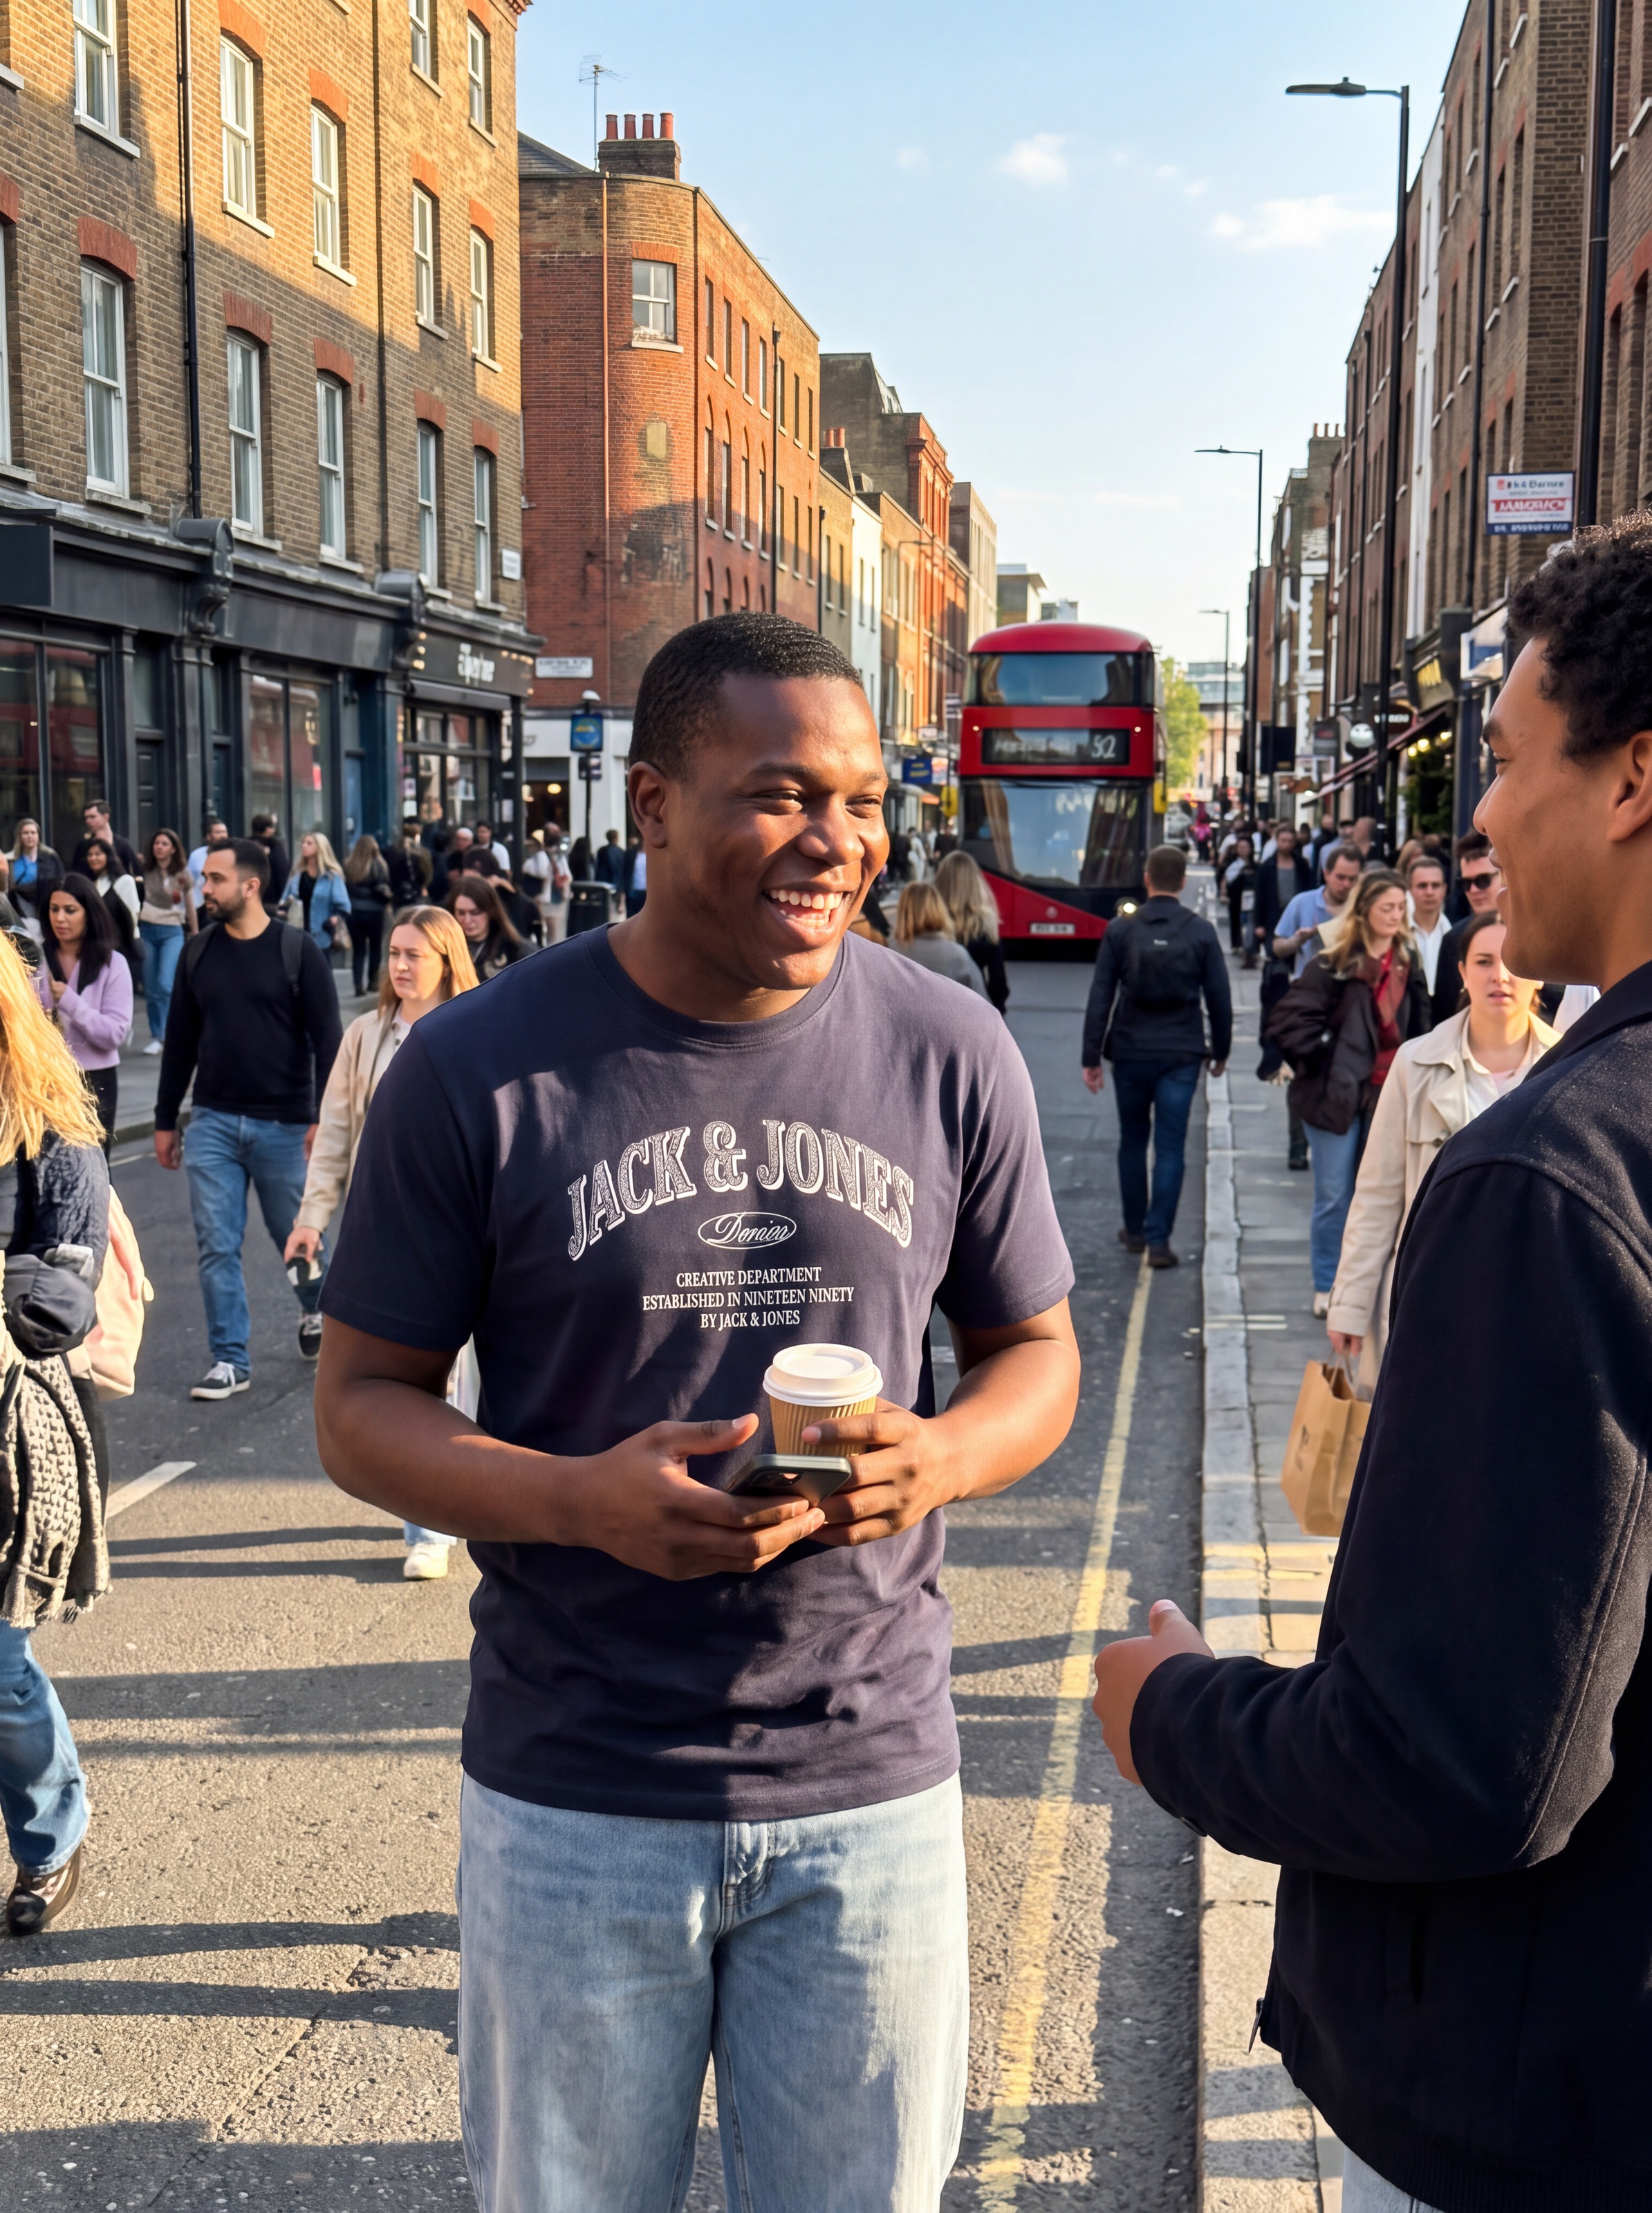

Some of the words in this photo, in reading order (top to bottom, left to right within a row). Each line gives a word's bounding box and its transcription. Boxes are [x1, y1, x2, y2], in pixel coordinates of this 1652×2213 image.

[566, 1126, 698, 1261] JACK
[703, 1120, 749, 1193] &
[757, 1119, 913, 1248] JONES
[676, 1270, 735, 1288] CREATIVE
[737, 1266, 822, 1285] DEPARTMENT
[642, 1293, 725, 1311] ESTABLISHED
[727, 1291, 741, 1307] IN
[743, 1288, 806, 1306] NINETEEN
[808, 1286, 855, 1303] NINETY
[700, 1313, 716, 1328] BY
[718, 1312, 748, 1332] JACK
[750, 1311, 760, 1326] &
[761, 1310, 801, 1326] JONES
